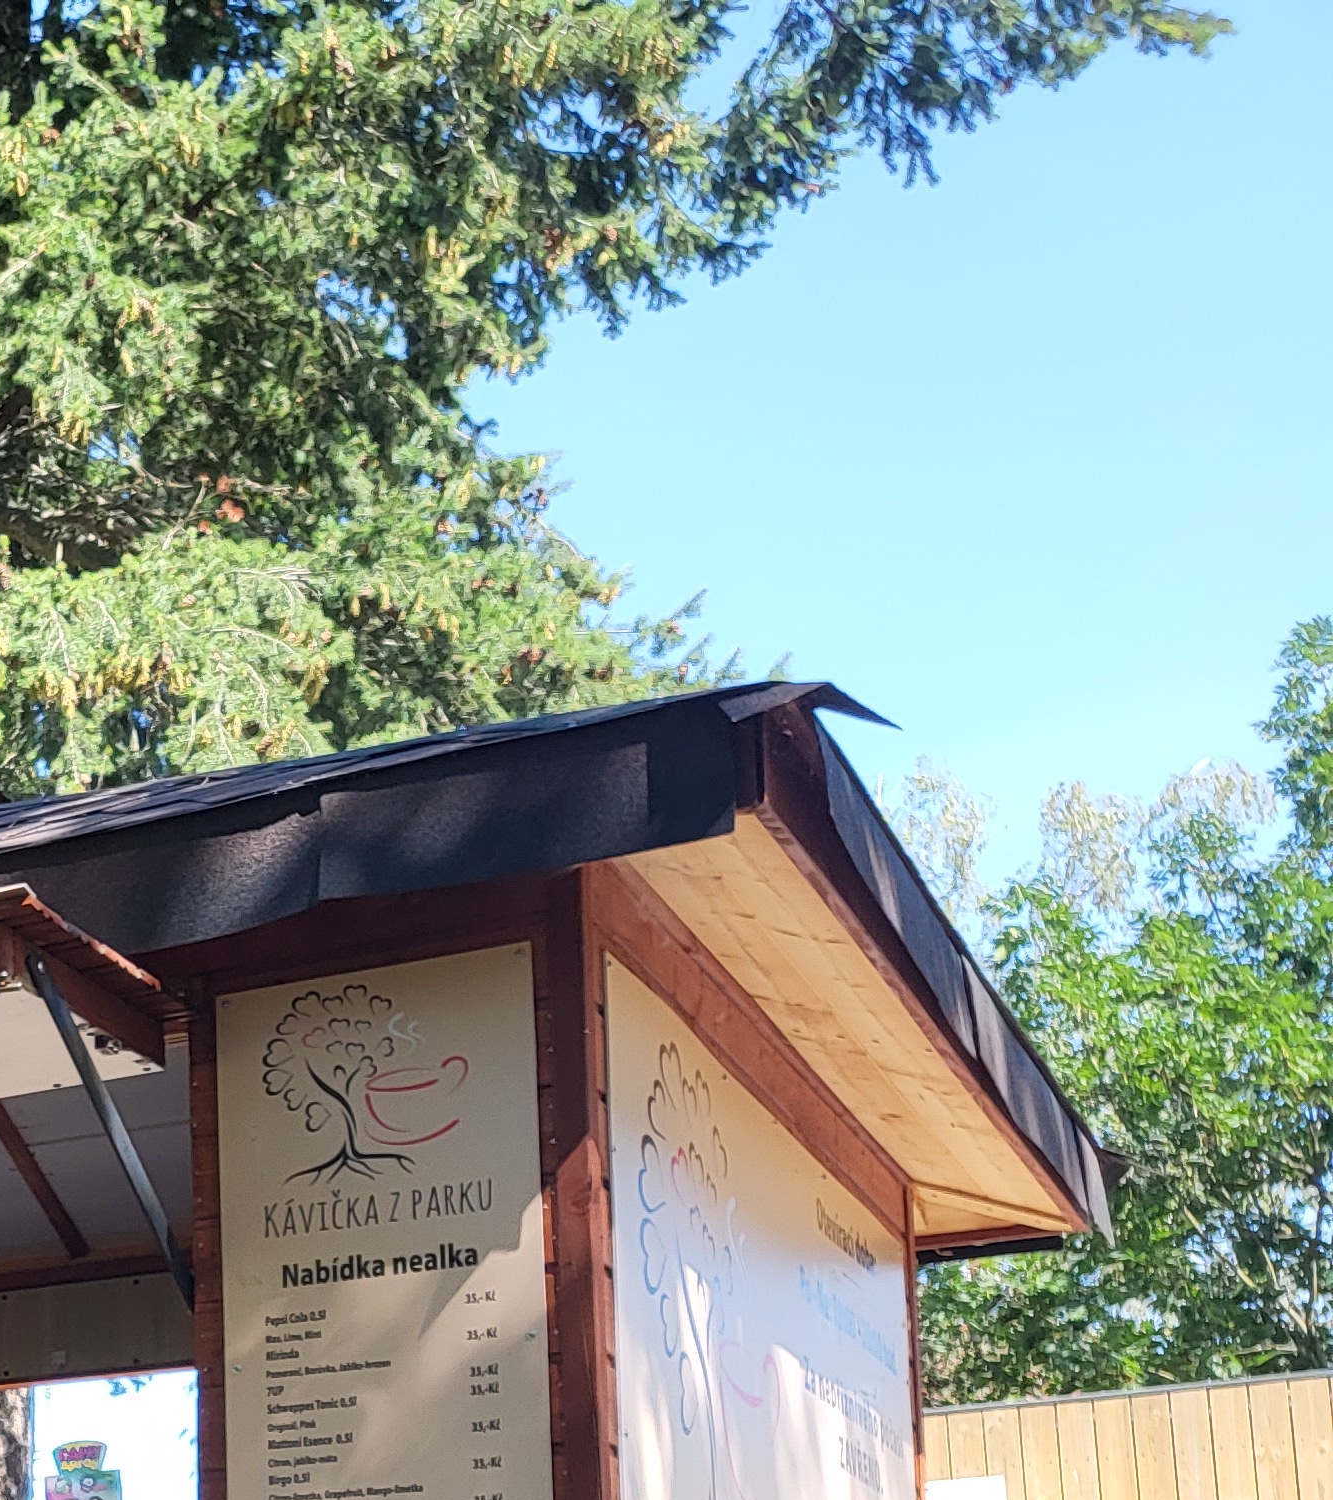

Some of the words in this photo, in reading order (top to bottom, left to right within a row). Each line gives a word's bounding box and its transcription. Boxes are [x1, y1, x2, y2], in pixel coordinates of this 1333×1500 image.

[263, 1189, 379, 1239] KÁVIČKA
[387, 1191, 401, 1223] Z
[411, 1178, 494, 1220] PARKU
[281, 1252, 386, 1289] Nabídka
[392, 1243, 479, 1277] nealka
